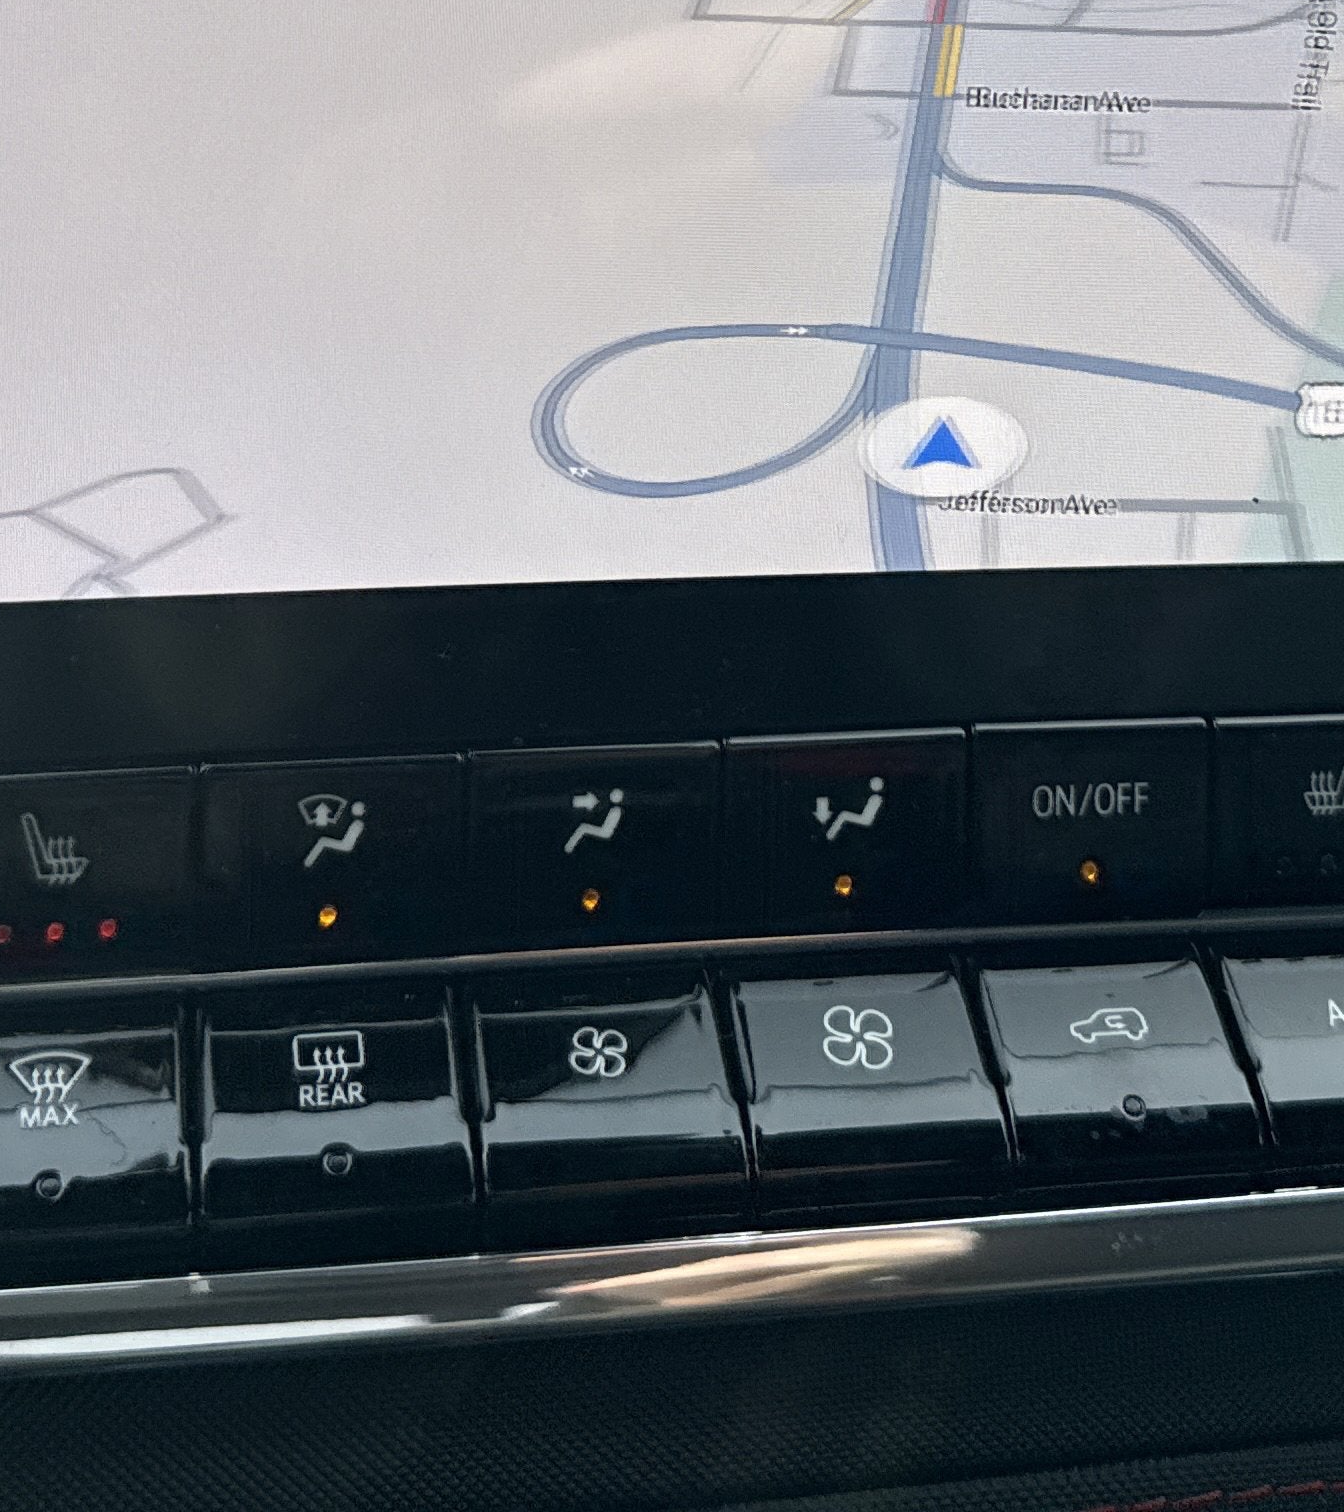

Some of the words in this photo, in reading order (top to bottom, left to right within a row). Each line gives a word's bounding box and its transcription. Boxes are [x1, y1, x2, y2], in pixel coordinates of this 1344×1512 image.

[1304, 10, 1339, 51] Old
[966, 86, 1100, 112] Buchanan
[1098, 90, 1152, 113] Ave
[1290, 60, 1330, 111] Trail
[939, 490, 1063, 514] Jefferson
[1063, 494, 1117, 515] Ave
[1032, 781, 1149, 819] ON/OFF
[298, 1080, 367, 1109] REAR
[20, 1103, 79, 1129] MAX
